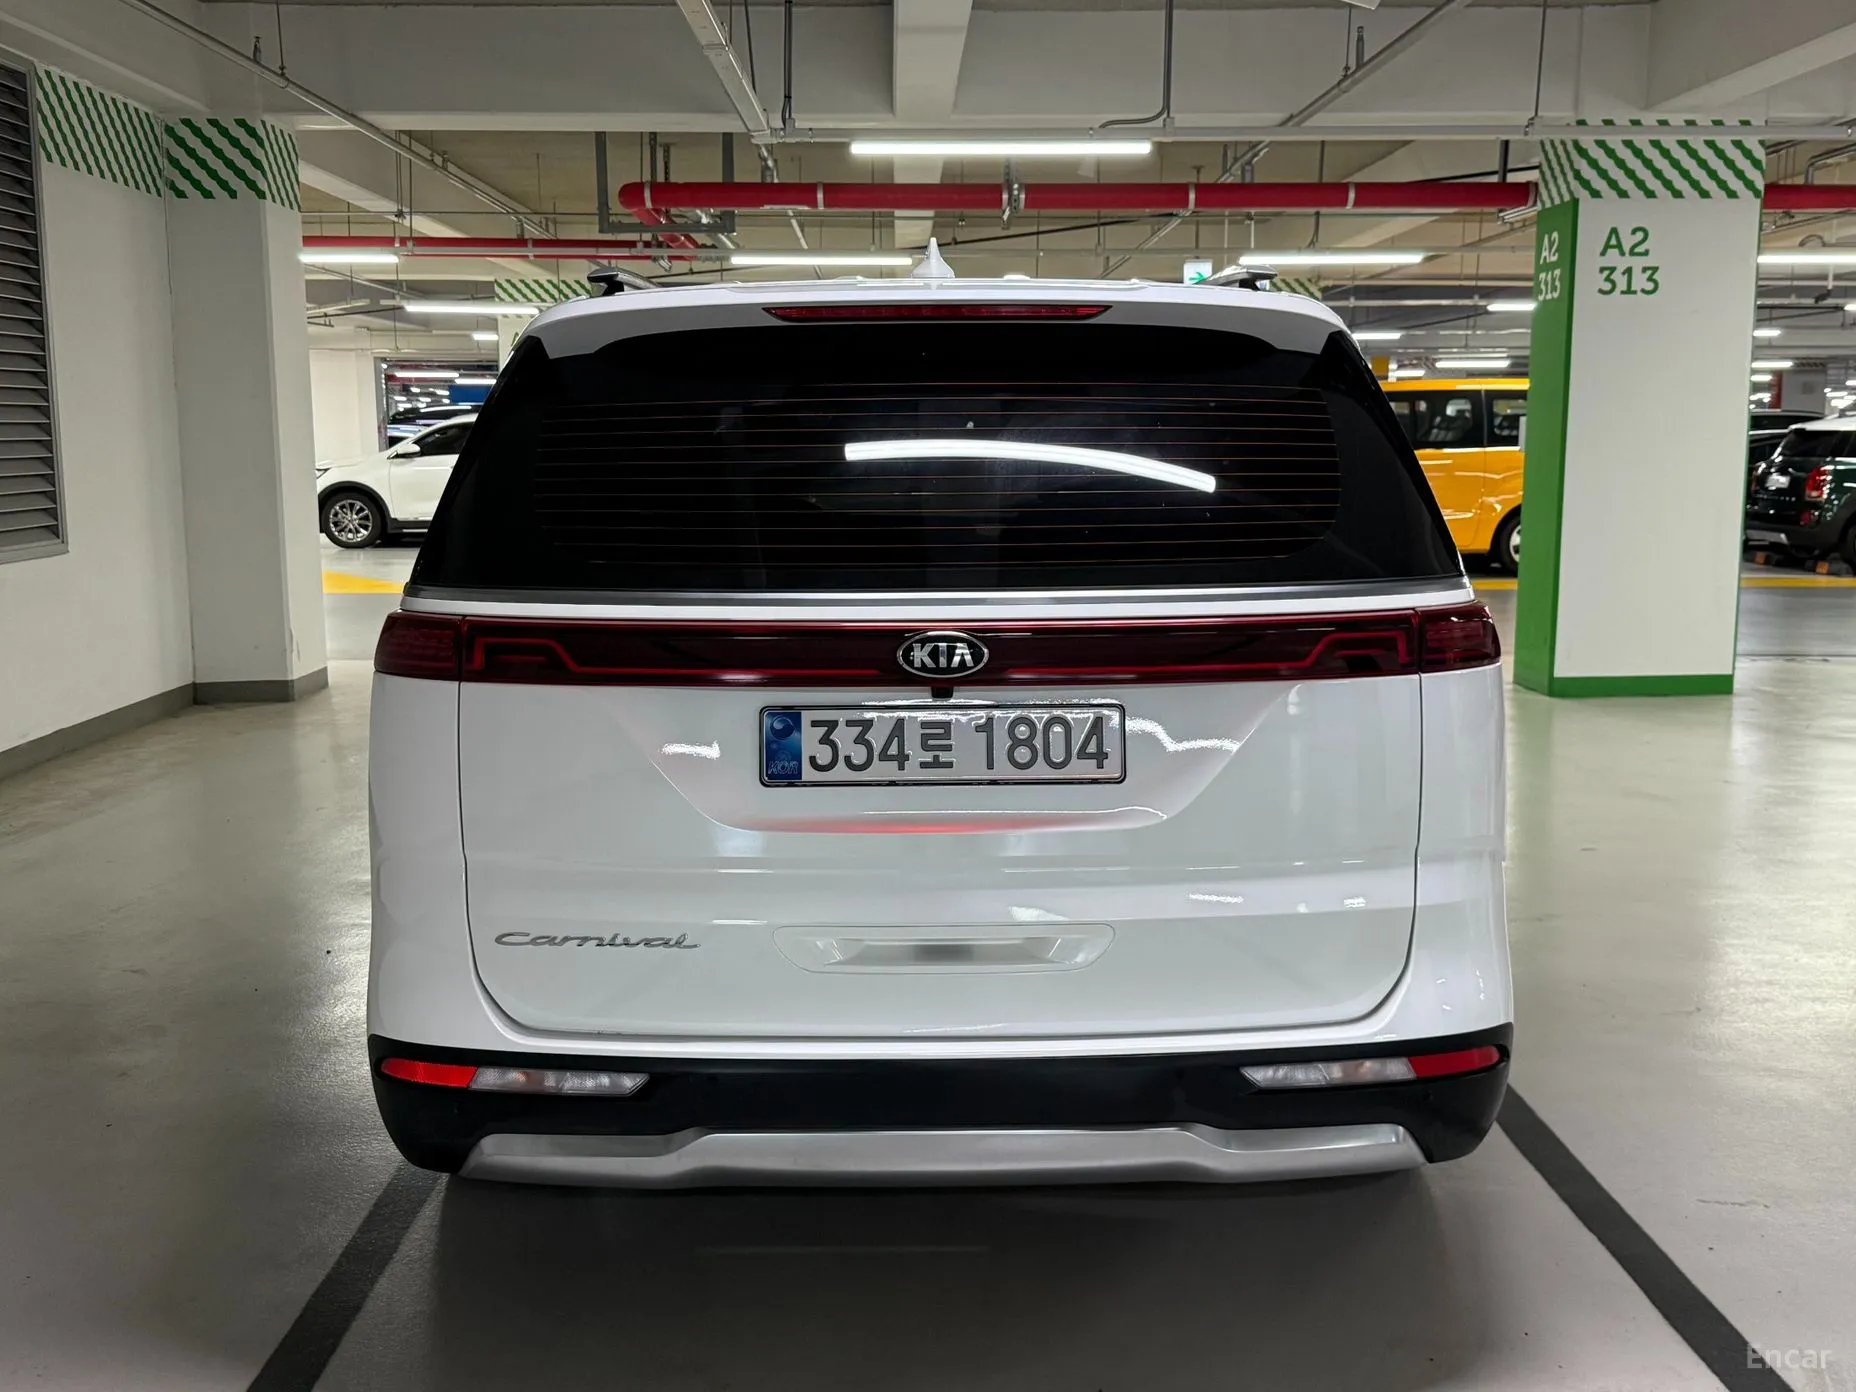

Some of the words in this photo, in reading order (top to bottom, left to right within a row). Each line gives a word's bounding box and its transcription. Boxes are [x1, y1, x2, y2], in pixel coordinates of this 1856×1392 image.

[1540, 231, 1559, 264] A2
[1599, 226, 1650, 257] A2
[1538, 269, 1561, 301] 313
[1597, 266, 1660, 295] 313
[912, 643, 975, 668] KIA
[809, 718, 954, 772] 334로
[975, 716, 1109, 771] 1804
[767, 760, 799, 775] KOR
[494, 931, 701, 949] Carnival
